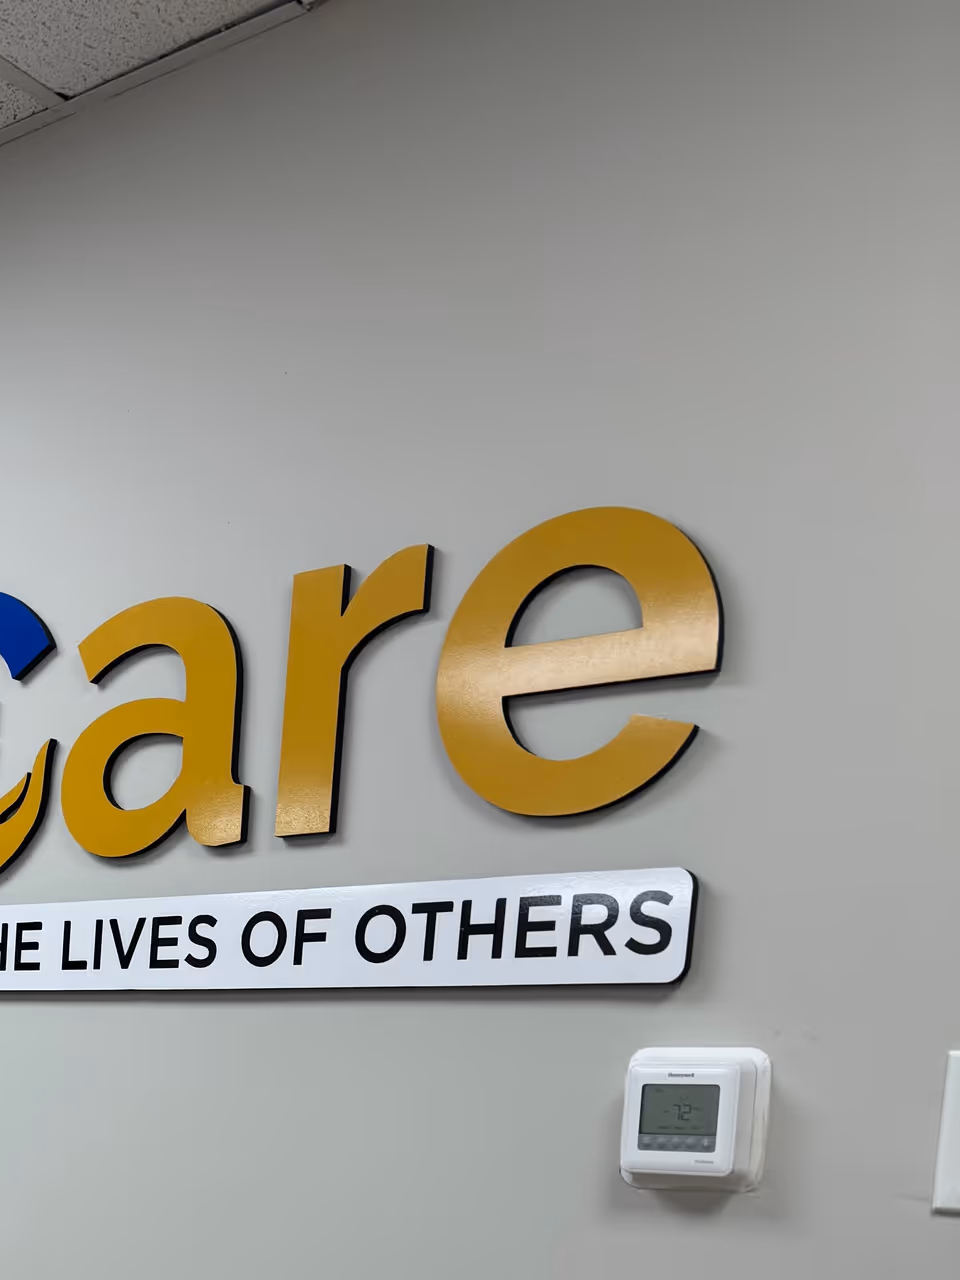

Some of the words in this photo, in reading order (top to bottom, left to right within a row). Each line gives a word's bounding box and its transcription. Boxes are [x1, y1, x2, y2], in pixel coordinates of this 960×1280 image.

[60, 914, 218, 971] LIVES
[240, 907, 333, 968] OF
[354, 889, 674, 965] OTHERS
[672, 1103, 692, 1121] 72
